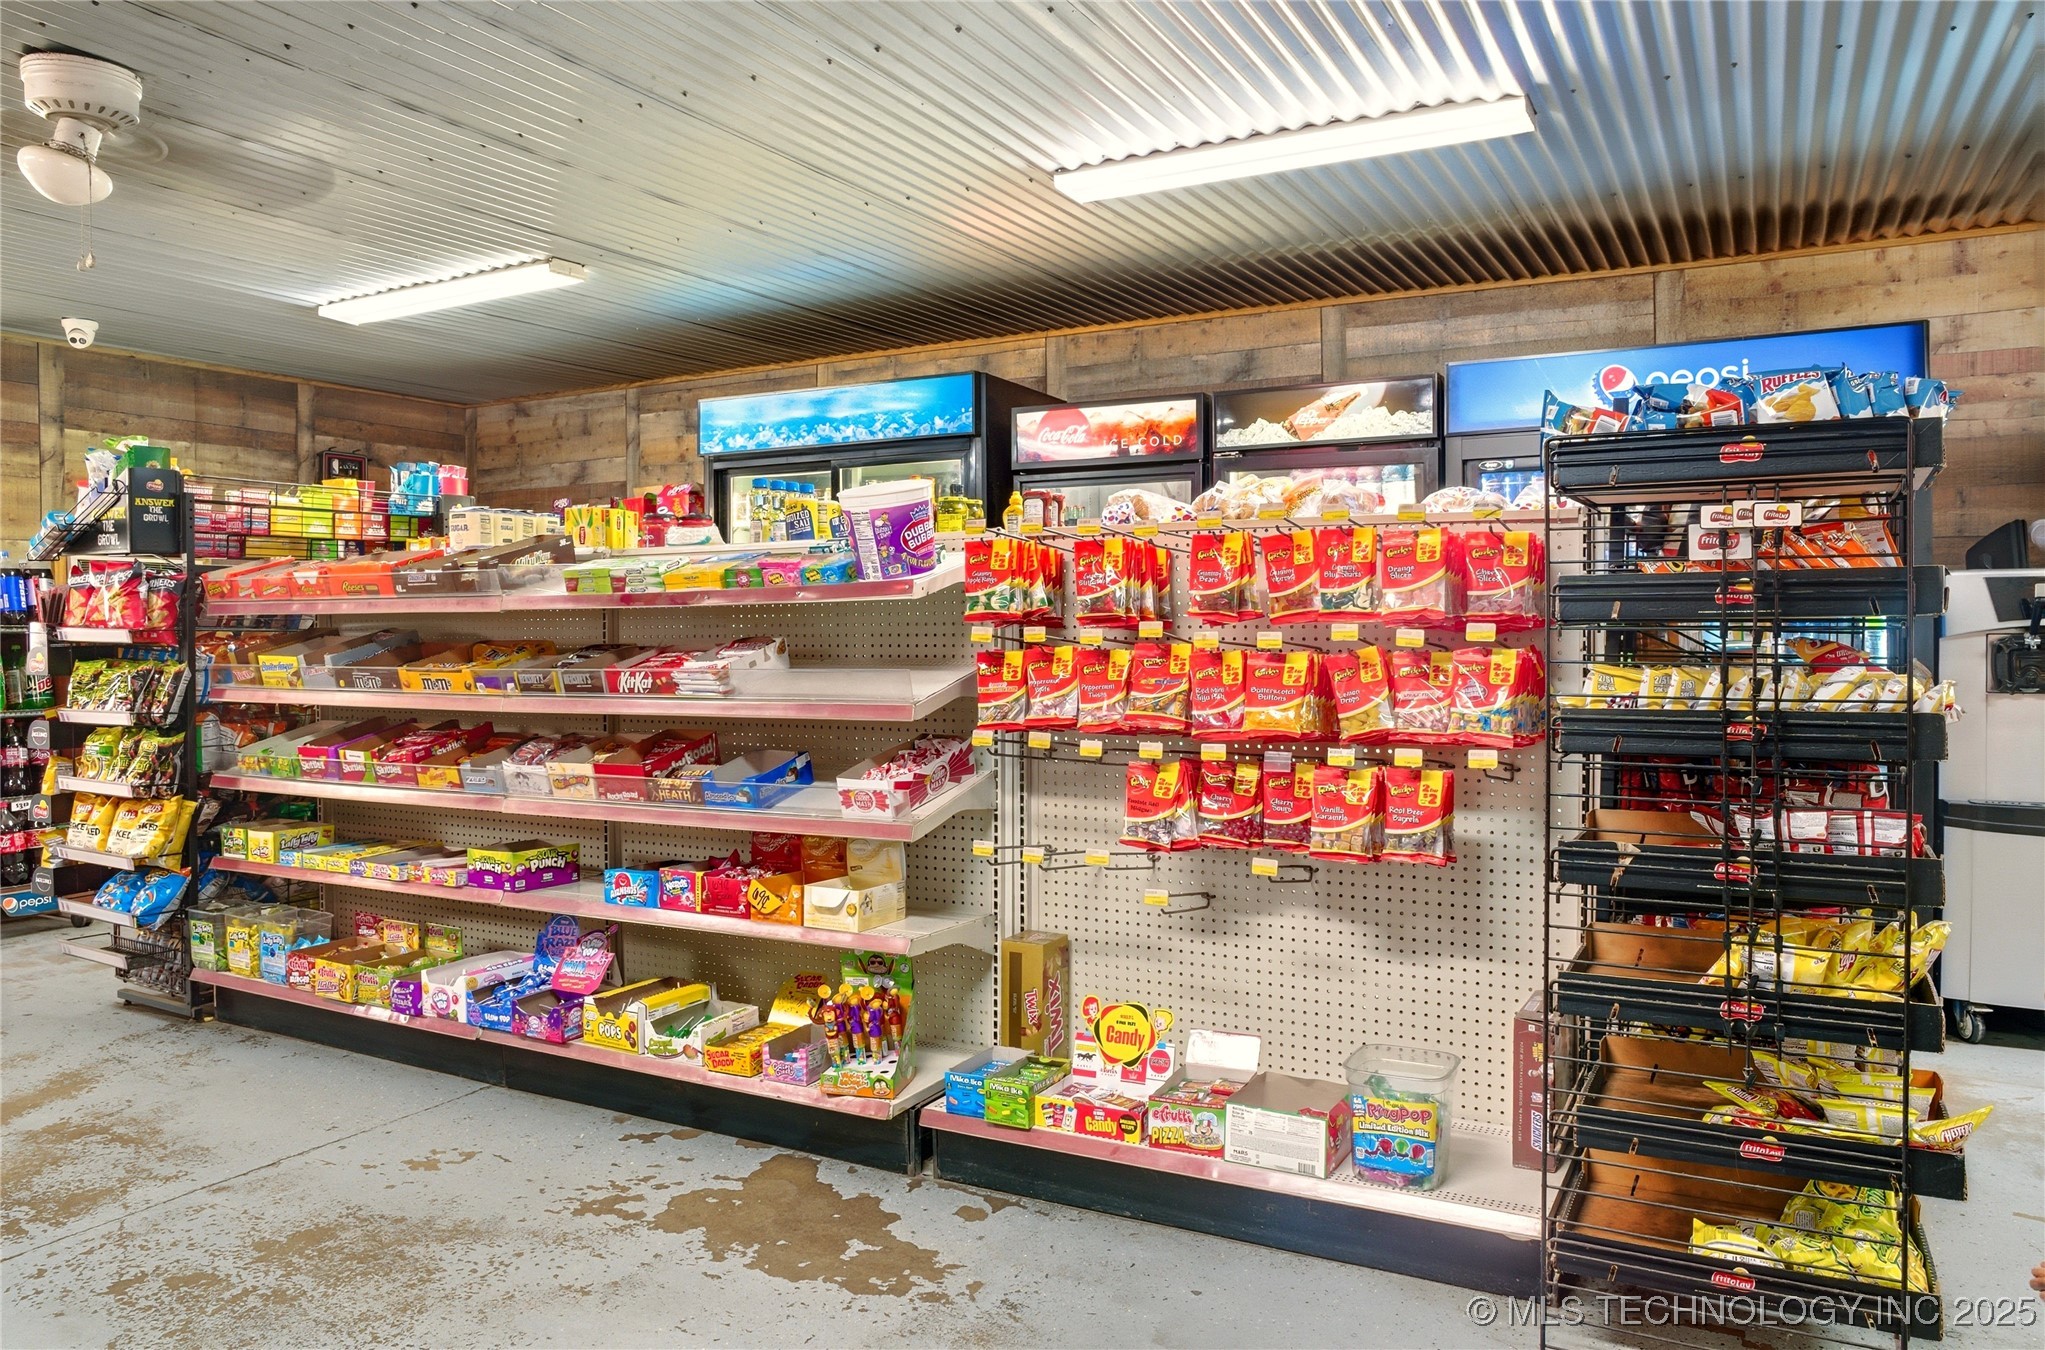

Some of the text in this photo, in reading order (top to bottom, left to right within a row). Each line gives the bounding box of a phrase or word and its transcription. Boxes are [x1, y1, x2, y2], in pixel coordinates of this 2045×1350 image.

[1761, 370, 1822, 394] RUFFLES
[1103, 434, 1183, 449] ICE COLD
[134, 498, 175, 507] ANSWER
[143, 514, 169, 522] GROWL
[793, 518, 811, 529] SALT
[102, 520, 115, 532] THE
[97, 534, 120, 546] GROWL
[1388, 565, 1415, 574] Orange
[1390, 571, 1412, 579] Slices
[1477, 574, 1500, 582] Slices
[563, 673, 592, 684] HERSHEY'S
[1081, 683, 1115, 691] Peppermint
[1250, 686, 1296, 695] Butterscotch
[1340, 696, 1360, 704] Drops
[686, 739, 713, 764] Road
[607, 791, 621, 800] Rocky
[658, 789, 692, 803] HEATH
[1270, 797, 1293, 807] Cherry
[1272, 804, 1292, 813] Sours
[1320, 806, 1345, 814] Vanilla
[1315, 812, 1348, 822] Caramels
[1393, 814, 1419, 823] Barrels
[300, 831, 319, 845] Taffy
[475, 861, 502, 874] PUNCH
[529, 856, 566, 873] PUNCH
[19, 896, 52, 909] pepsi
[549, 925, 577, 937] BLUE
[794, 973, 823, 983] SUGAR
[797, 980, 825, 990] DADDY
[1024, 988, 1039, 1025] TWIX
[1044, 971, 1065, 1057] TWIX
[598, 1021, 622, 1040] POPS
[1105, 1025, 1145, 1052] Candy
[706, 1049, 730, 1061] SUGAR
[712, 1057, 735, 1067] DADDY
[989, 1082, 1010, 1093] Mike
[1151, 1103, 1194, 1124] efrutti
[1085, 1115, 1118, 1137] Candy
[1359, 1121, 1430, 1138] Limited Edition Mix
[1532, 1111, 1543, 1152] SNICKERS
[1151, 1126, 1185, 1144] PIZZA
[1233, 1149, 1249, 1157] MARS
